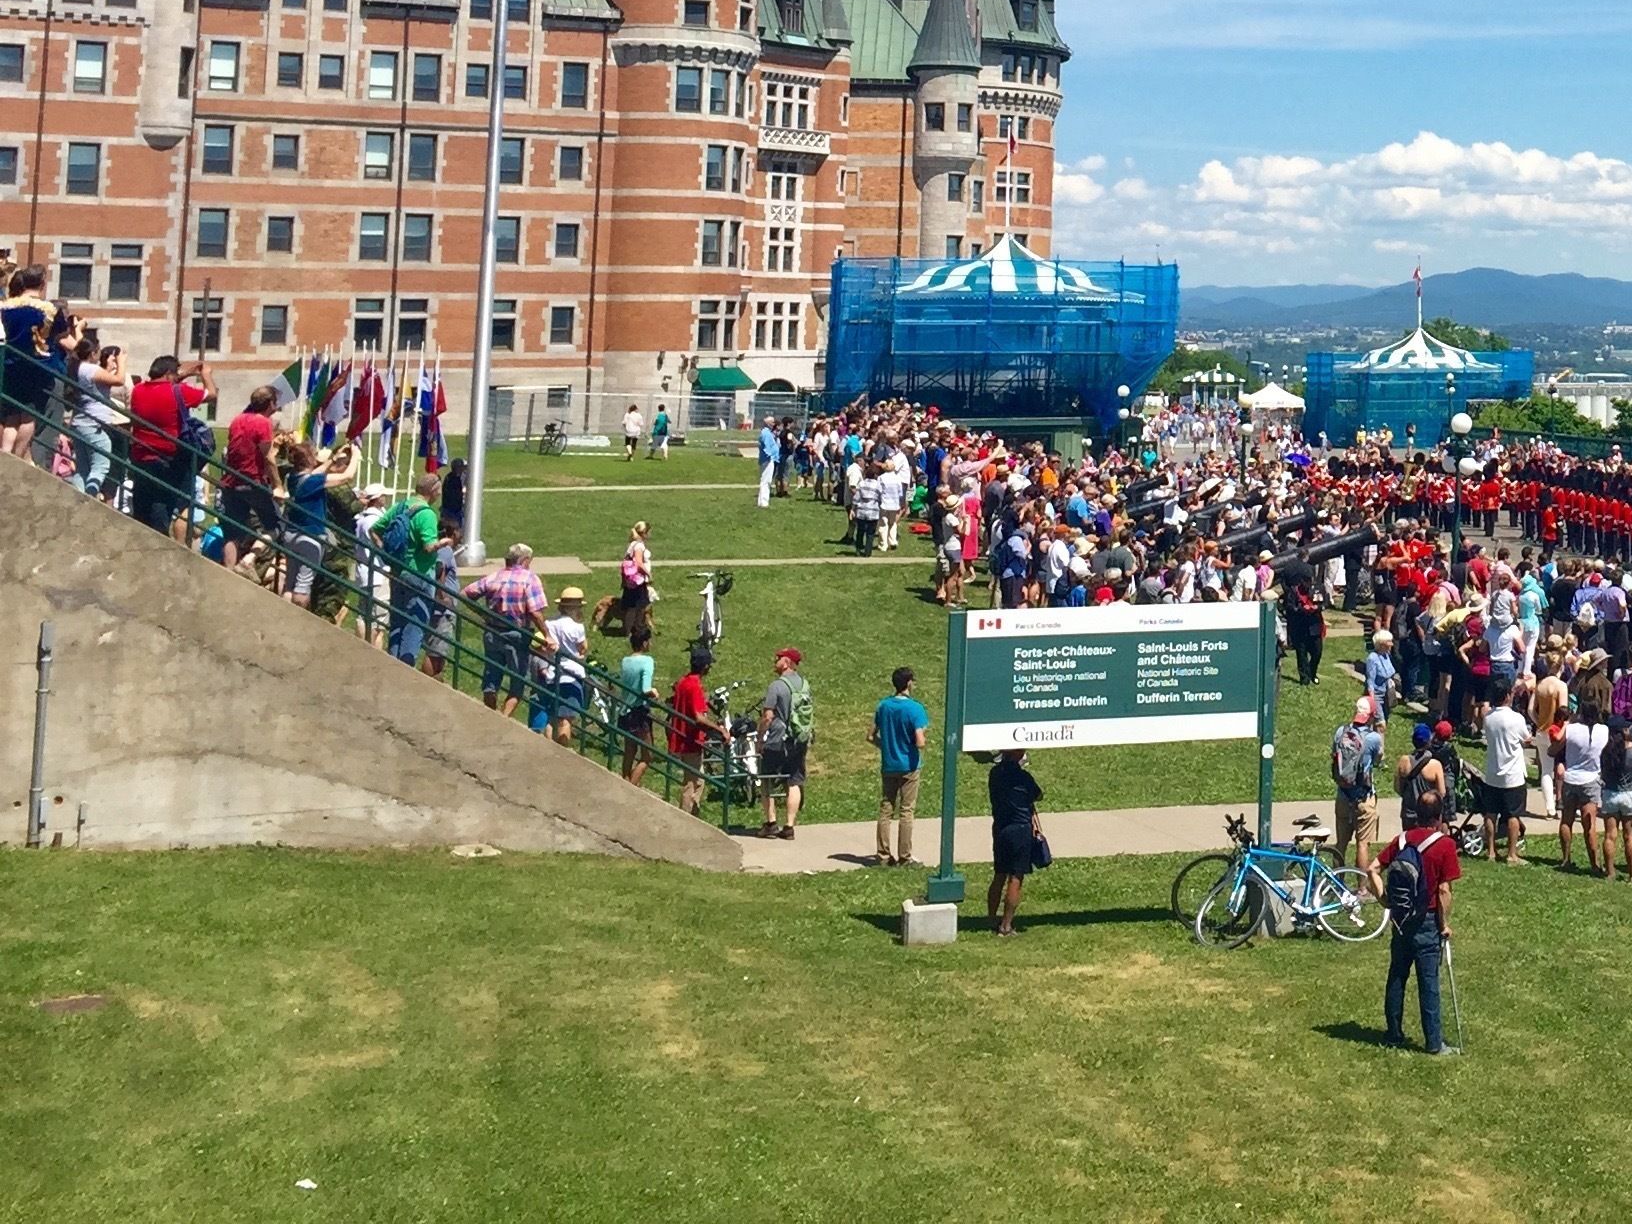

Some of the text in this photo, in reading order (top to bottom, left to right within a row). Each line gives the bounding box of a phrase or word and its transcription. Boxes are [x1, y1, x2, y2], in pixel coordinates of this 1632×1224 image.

[1036, 621, 1061, 629] Canada
[1014, 645, 1117, 658] Forts-et-Châteaux-
[1137, 640, 1229, 654] Saint-Louis Forts
[1013, 659, 1077, 671] Saint-Louis
[1137, 653, 1211, 666] and Châteaux
[1032, 673, 1073, 683] historique
[1074, 671, 1107, 681] national
[1137, 666, 1219, 678] National Historic Site
[1013, 683, 1059, 694] du Canada
[1136, 678, 1179, 688] of Canada
[1013, 695, 1108, 709] Terrasse Dufferin
[1136, 690, 1223, 704] Dufferin Terrace
[1012, 725, 1075, 743] Canada
